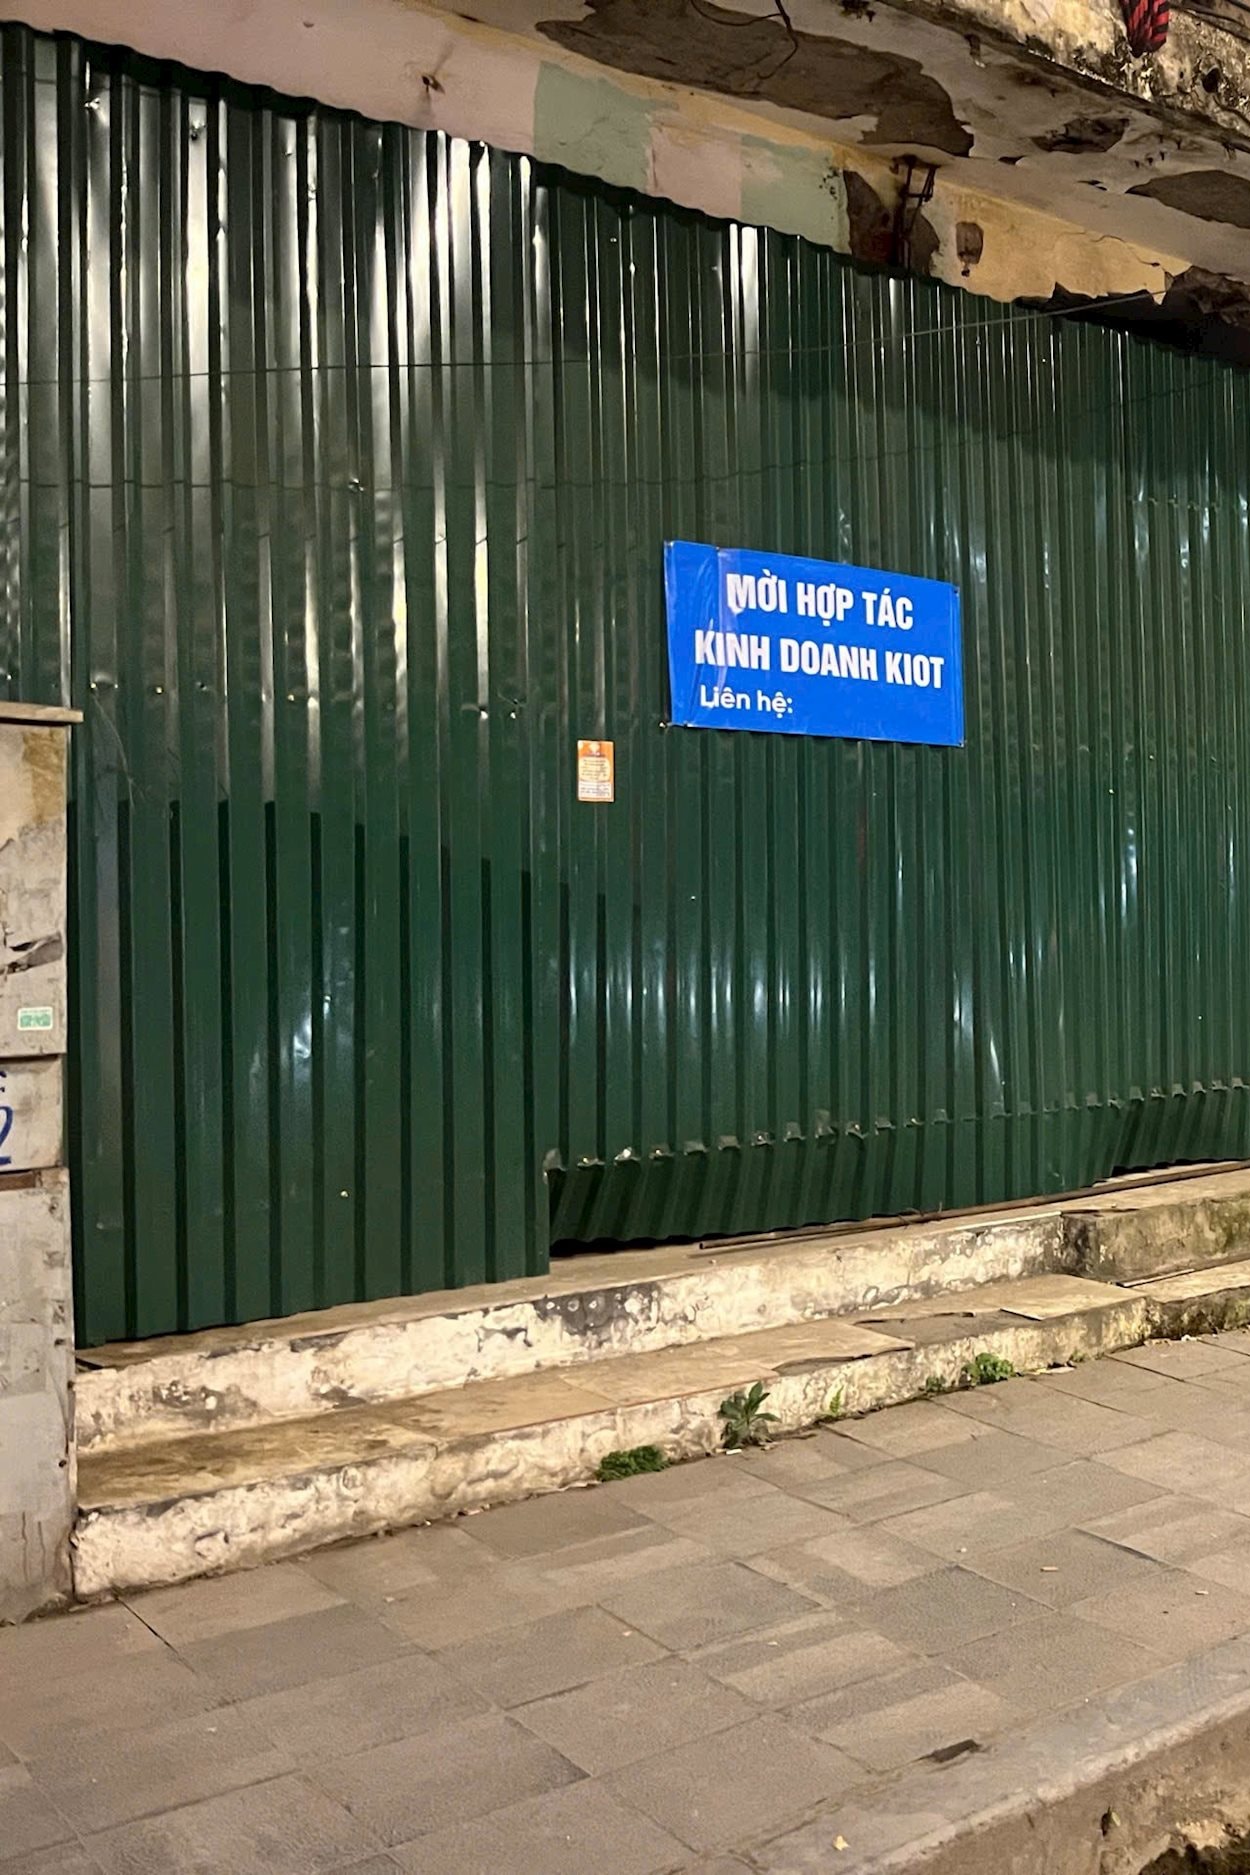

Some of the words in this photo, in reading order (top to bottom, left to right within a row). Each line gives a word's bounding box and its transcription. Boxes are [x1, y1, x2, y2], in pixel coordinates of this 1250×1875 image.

[726, 569, 788, 612] MỜI
[796, 581, 854, 627] HỢP
[862, 587, 914, 631] TÁC
[694, 629, 770, 671] KINH
[780, 639, 878, 682] DOANH
[885, 651, 945, 689] KIOT
[699, 684, 751, 710] Liên
[757, 690, 793, 718] hệ:
